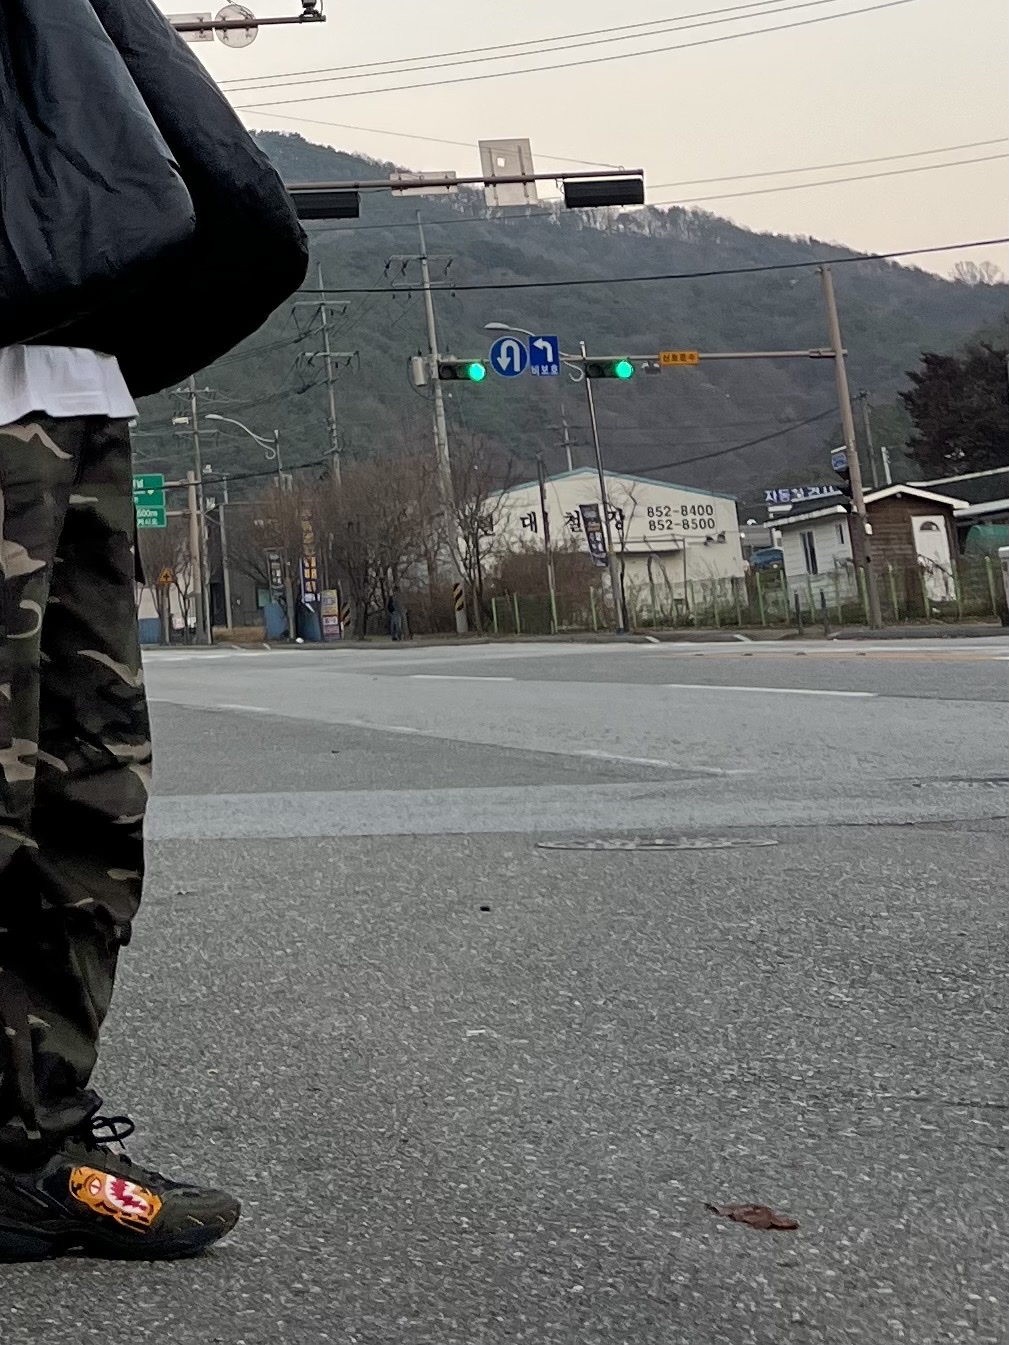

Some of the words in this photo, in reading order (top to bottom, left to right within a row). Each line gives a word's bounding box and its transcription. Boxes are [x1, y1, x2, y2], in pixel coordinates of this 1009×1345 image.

[531, 364, 559, 377] 비보호
[647, 504, 714, 517] 852-8400
[648, 518, 715, 531] 852-8500
